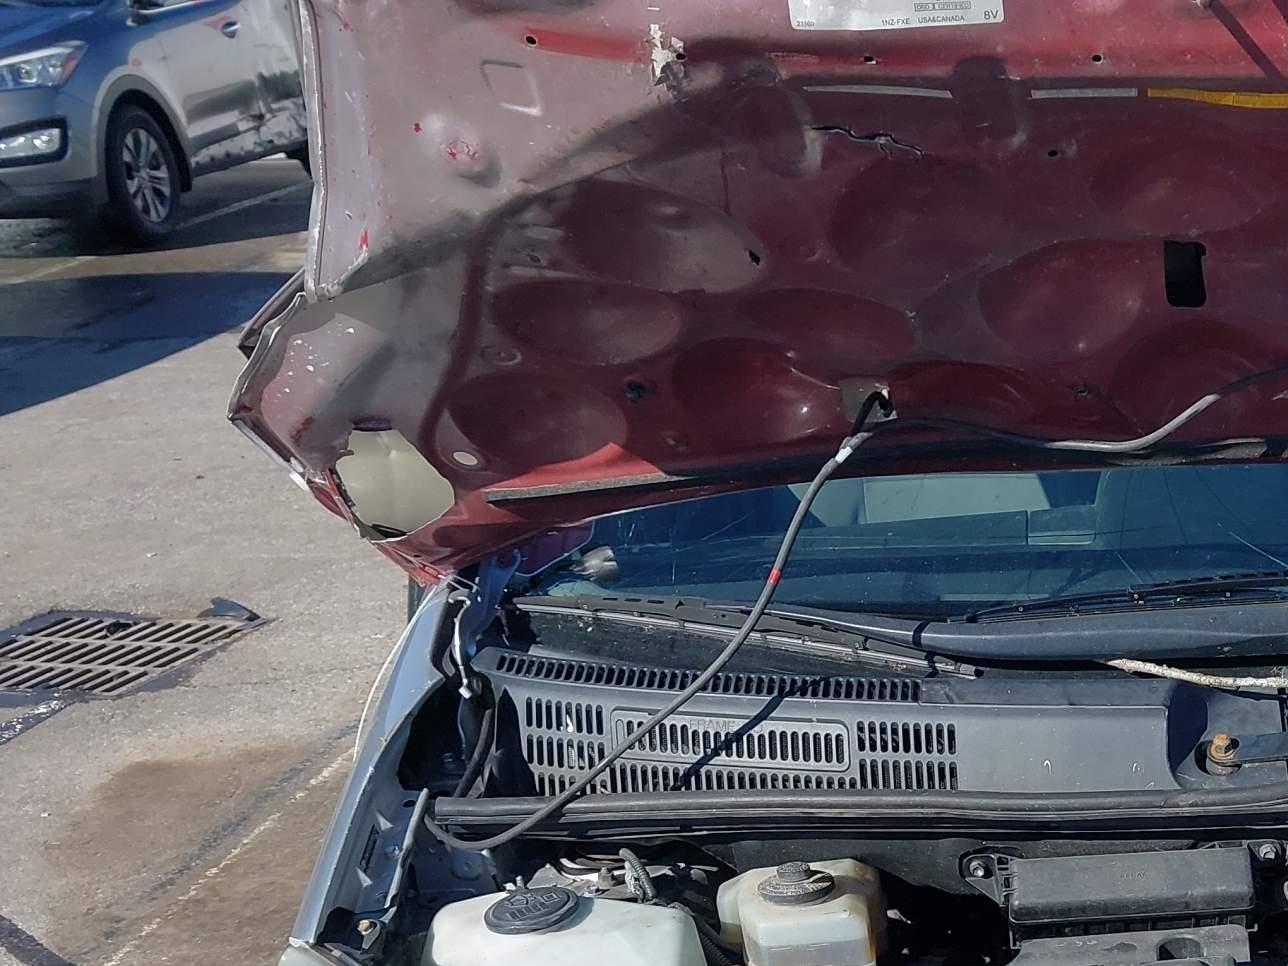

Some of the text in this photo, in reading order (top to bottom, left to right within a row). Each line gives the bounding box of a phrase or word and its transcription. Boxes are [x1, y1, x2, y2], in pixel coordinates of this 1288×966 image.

[983, 8, 999, 20] 8V
[881, 15, 965, 26] 1NZ-FXE USA&CANADA
[689, 719, 736, 731] FRAME
